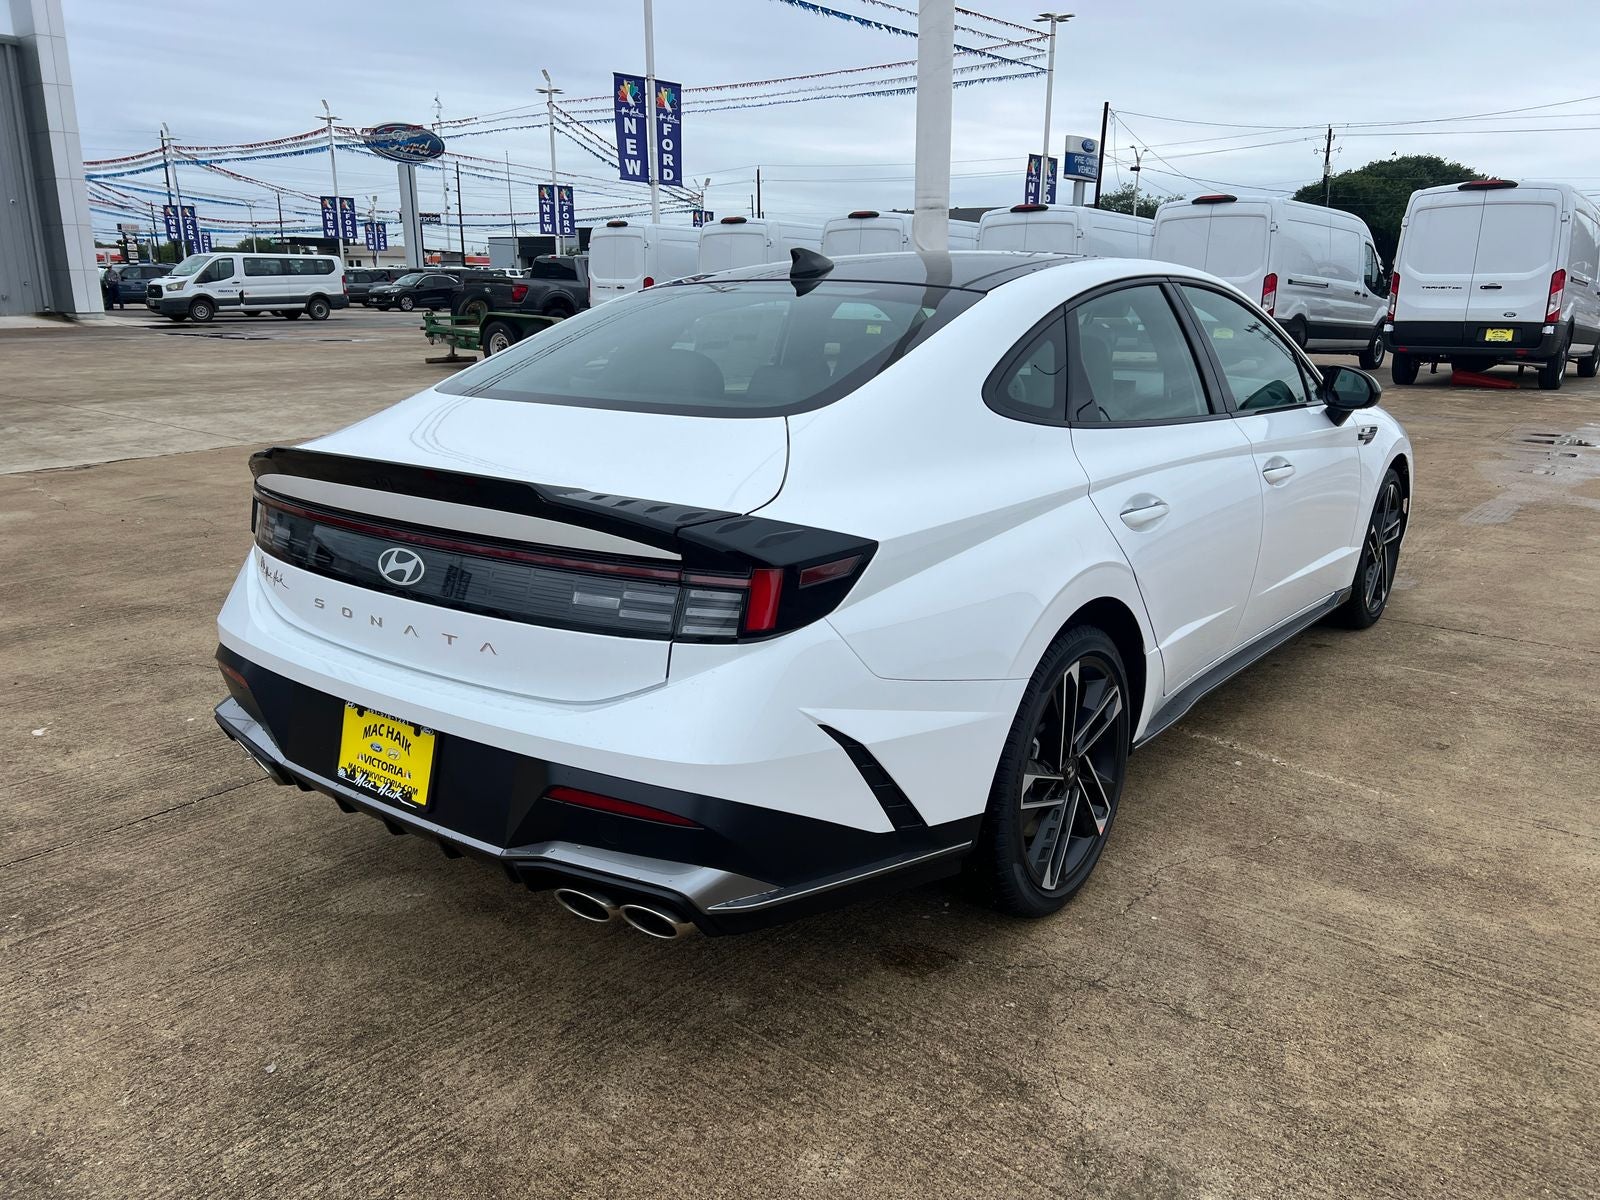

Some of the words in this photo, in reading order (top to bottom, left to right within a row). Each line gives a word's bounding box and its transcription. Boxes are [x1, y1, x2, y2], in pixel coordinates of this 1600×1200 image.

[623, 117, 641, 176] NEW
[661, 123, 675, 181] FORD
[169, 219, 178, 239] NEW
[186, 220, 194, 240] FORD
[325, 212, 336, 237] NEW
[345, 214, 353, 238] FORD
[543, 204, 552, 232] NEW
[562, 205, 571, 234] FORD
[367, 233, 375, 250] NEW
[314, 597, 498, 656] SONATA
[362, 723, 386, 740] MAC
[385, 725, 412, 758] HAIK
[363, 753, 404, 778] VICTORIA
[351, 773, 377, 791] Mac
[377, 782, 411, 803] Haik
